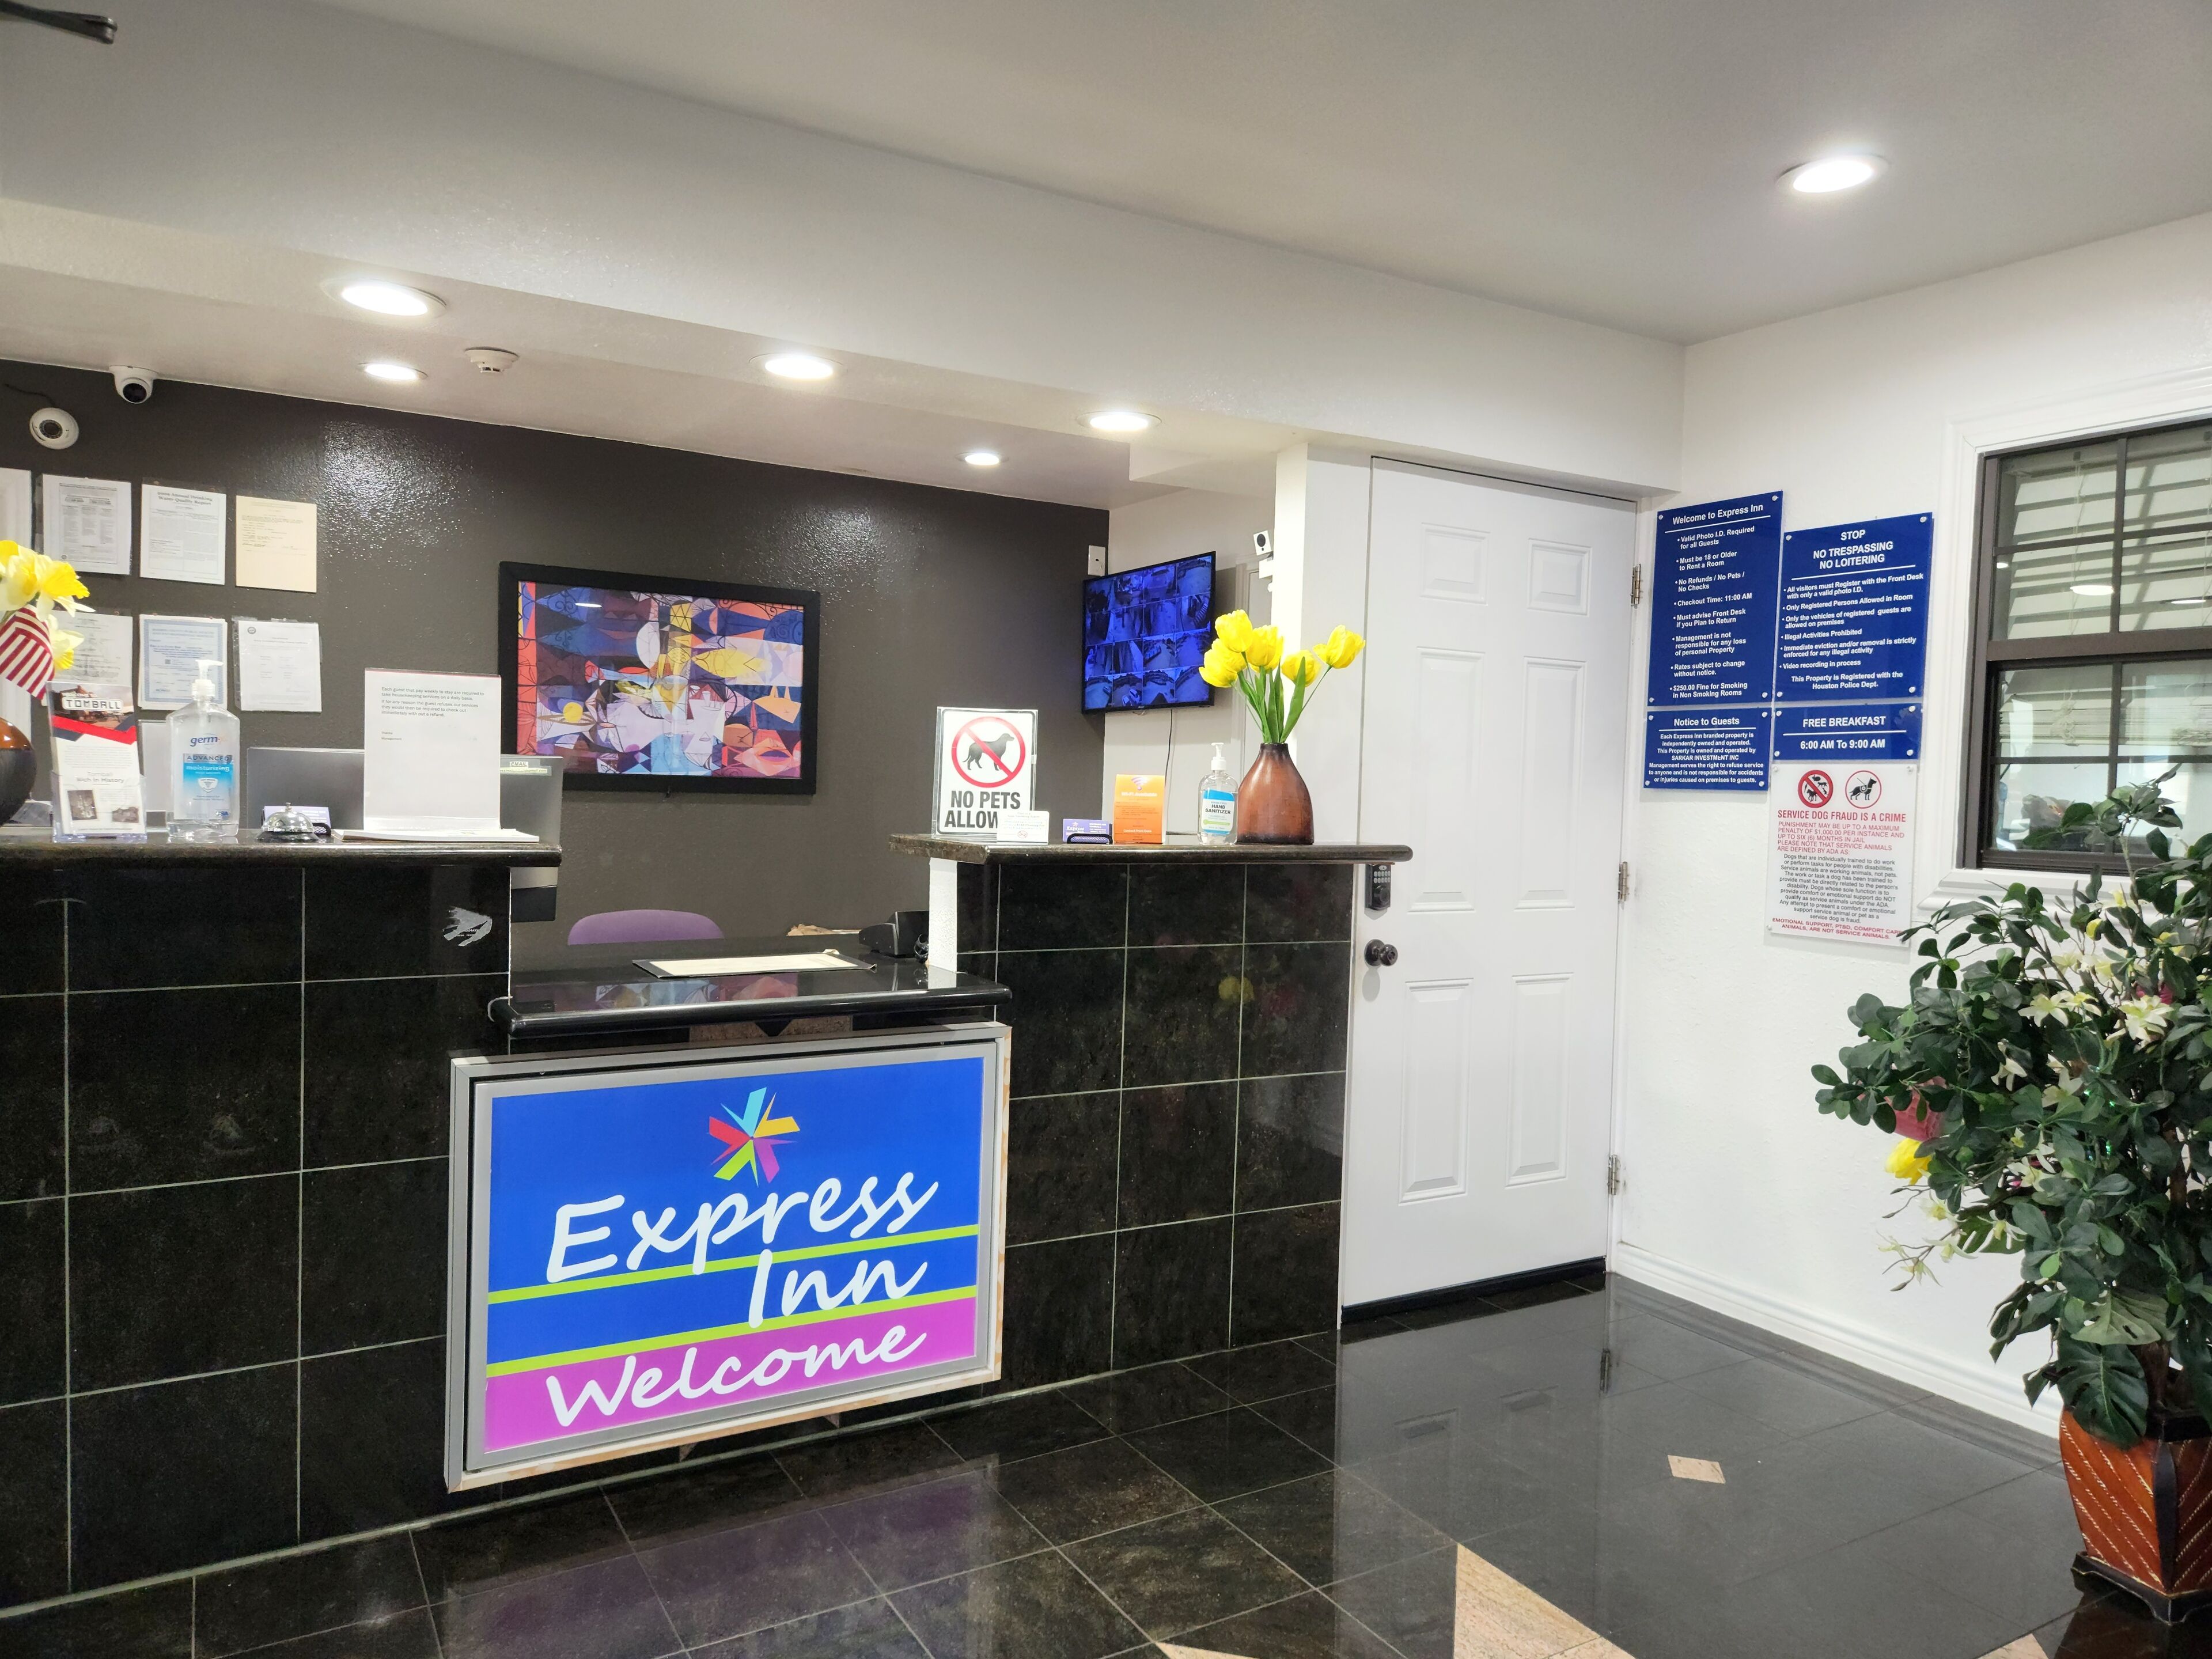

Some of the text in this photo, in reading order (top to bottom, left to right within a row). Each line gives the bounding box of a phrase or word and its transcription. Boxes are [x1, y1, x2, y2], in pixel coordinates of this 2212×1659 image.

[66, 123, 120, 134] TOMBALL
[1673, 514, 1706, 524] Welcome
[1717, 507, 1748, 518] Express
[1751, 504, 1763, 512] Inn
[1727, 525, 1754, 535] Required
[1840, 529, 1865, 540] STOP
[1813, 541, 1893, 559] NO TRESPASSING
[1820, 554, 1884, 569] NO LOITERING
[1677, 598, 1705, 606] Checkout
[1676, 633, 1713, 642] Management
[1831, 628, 1862, 637] Prohibited
[1675, 641, 1709, 649] responsible
[1682, 647, 1707, 657] personal
[1692, 662, 1714, 670] subject
[1721, 682, 1747, 691] Smoking
[1711, 717, 1739, 725] Guests
[1803, 716, 1886, 727] FREE BREAKFAST
[1800, 739, 1885, 749] 6:00 AM To 9:00 AM
[950, 790, 1021, 809] NO PETS
[944, 810, 998, 829] ALLOW
[1778, 810, 1906, 822] SERVICE DOG FRAUD IS A CRIME
[546, 1172, 939, 1285] Express
[748, 1249, 928, 1329] Inn
[546, 1324, 927, 1428] Welcome
